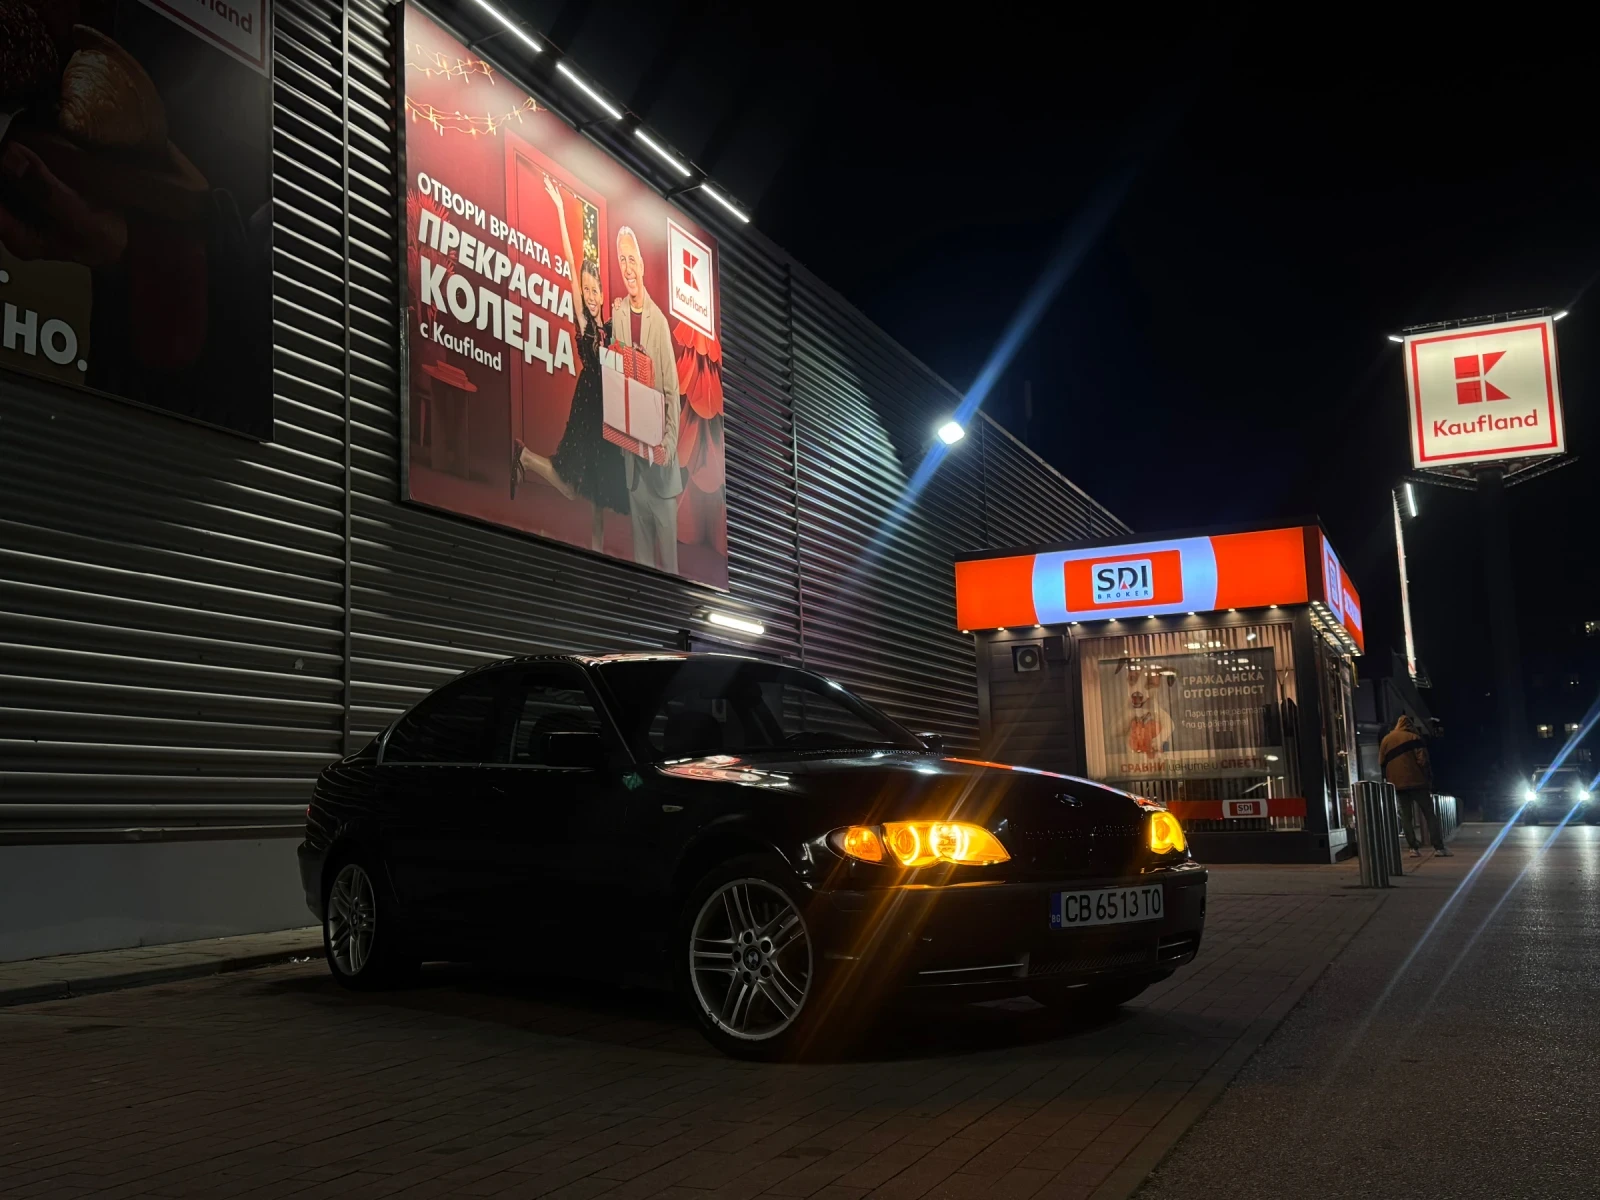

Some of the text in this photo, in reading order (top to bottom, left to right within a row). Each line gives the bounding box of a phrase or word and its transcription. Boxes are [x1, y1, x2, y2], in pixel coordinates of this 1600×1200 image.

[417, 172, 573, 281] ОТВОРИ ВРАТАТА ЗА
[418, 208, 574, 323] ПРЕКРАСНА
[420, 255, 576, 376] КОЛЕДА
[675, 286, 708, 318] Kaufland
[433, 321, 502, 371] Kaufland
[1434, 409, 1538, 437] Kaufland
[1097, 565, 1148, 592] SDI
[1097, 590, 1149, 600] BROKER
[1182, 671, 1265, 686] ГРАЖДАНСКА
[1183, 684, 1265, 698] ОТГОВОРНОСТ
[1120, 761, 1165, 774] СРАВНИ
[1168, 761, 1210, 774] цените
[1220, 756, 1268, 770] СПЕСТИ
[1237, 804, 1252, 812] SDI
[1051, 914, 1061, 924] BG
